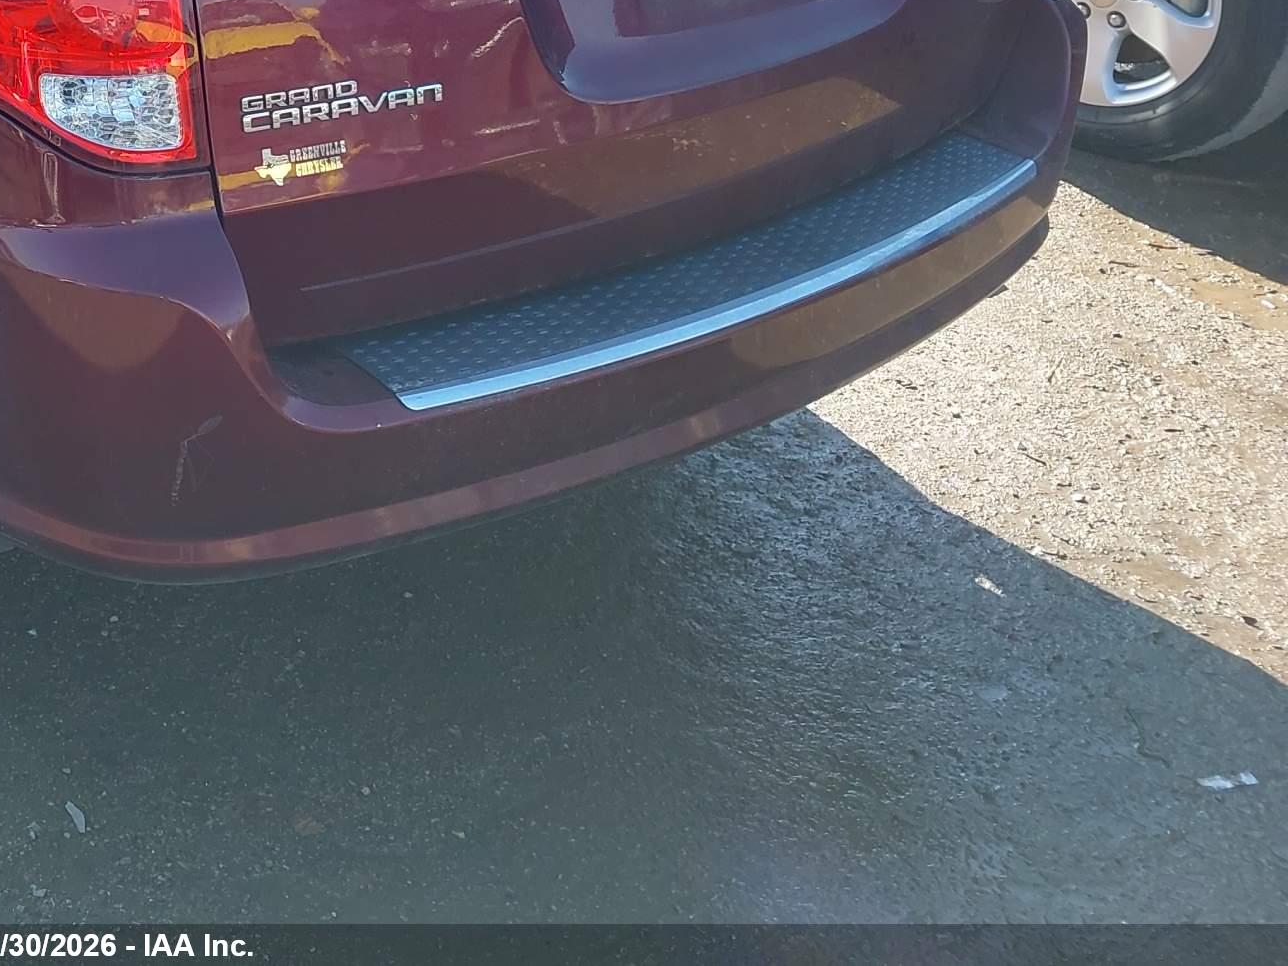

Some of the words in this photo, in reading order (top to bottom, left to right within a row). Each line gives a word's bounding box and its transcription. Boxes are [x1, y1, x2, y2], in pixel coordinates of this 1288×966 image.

[241, 80, 358, 113] GRAND
[242, 83, 444, 134] CARAVAN
[288, 139, 347, 163] GREENVILLE
[295, 157, 344, 178] CHRYSLER
